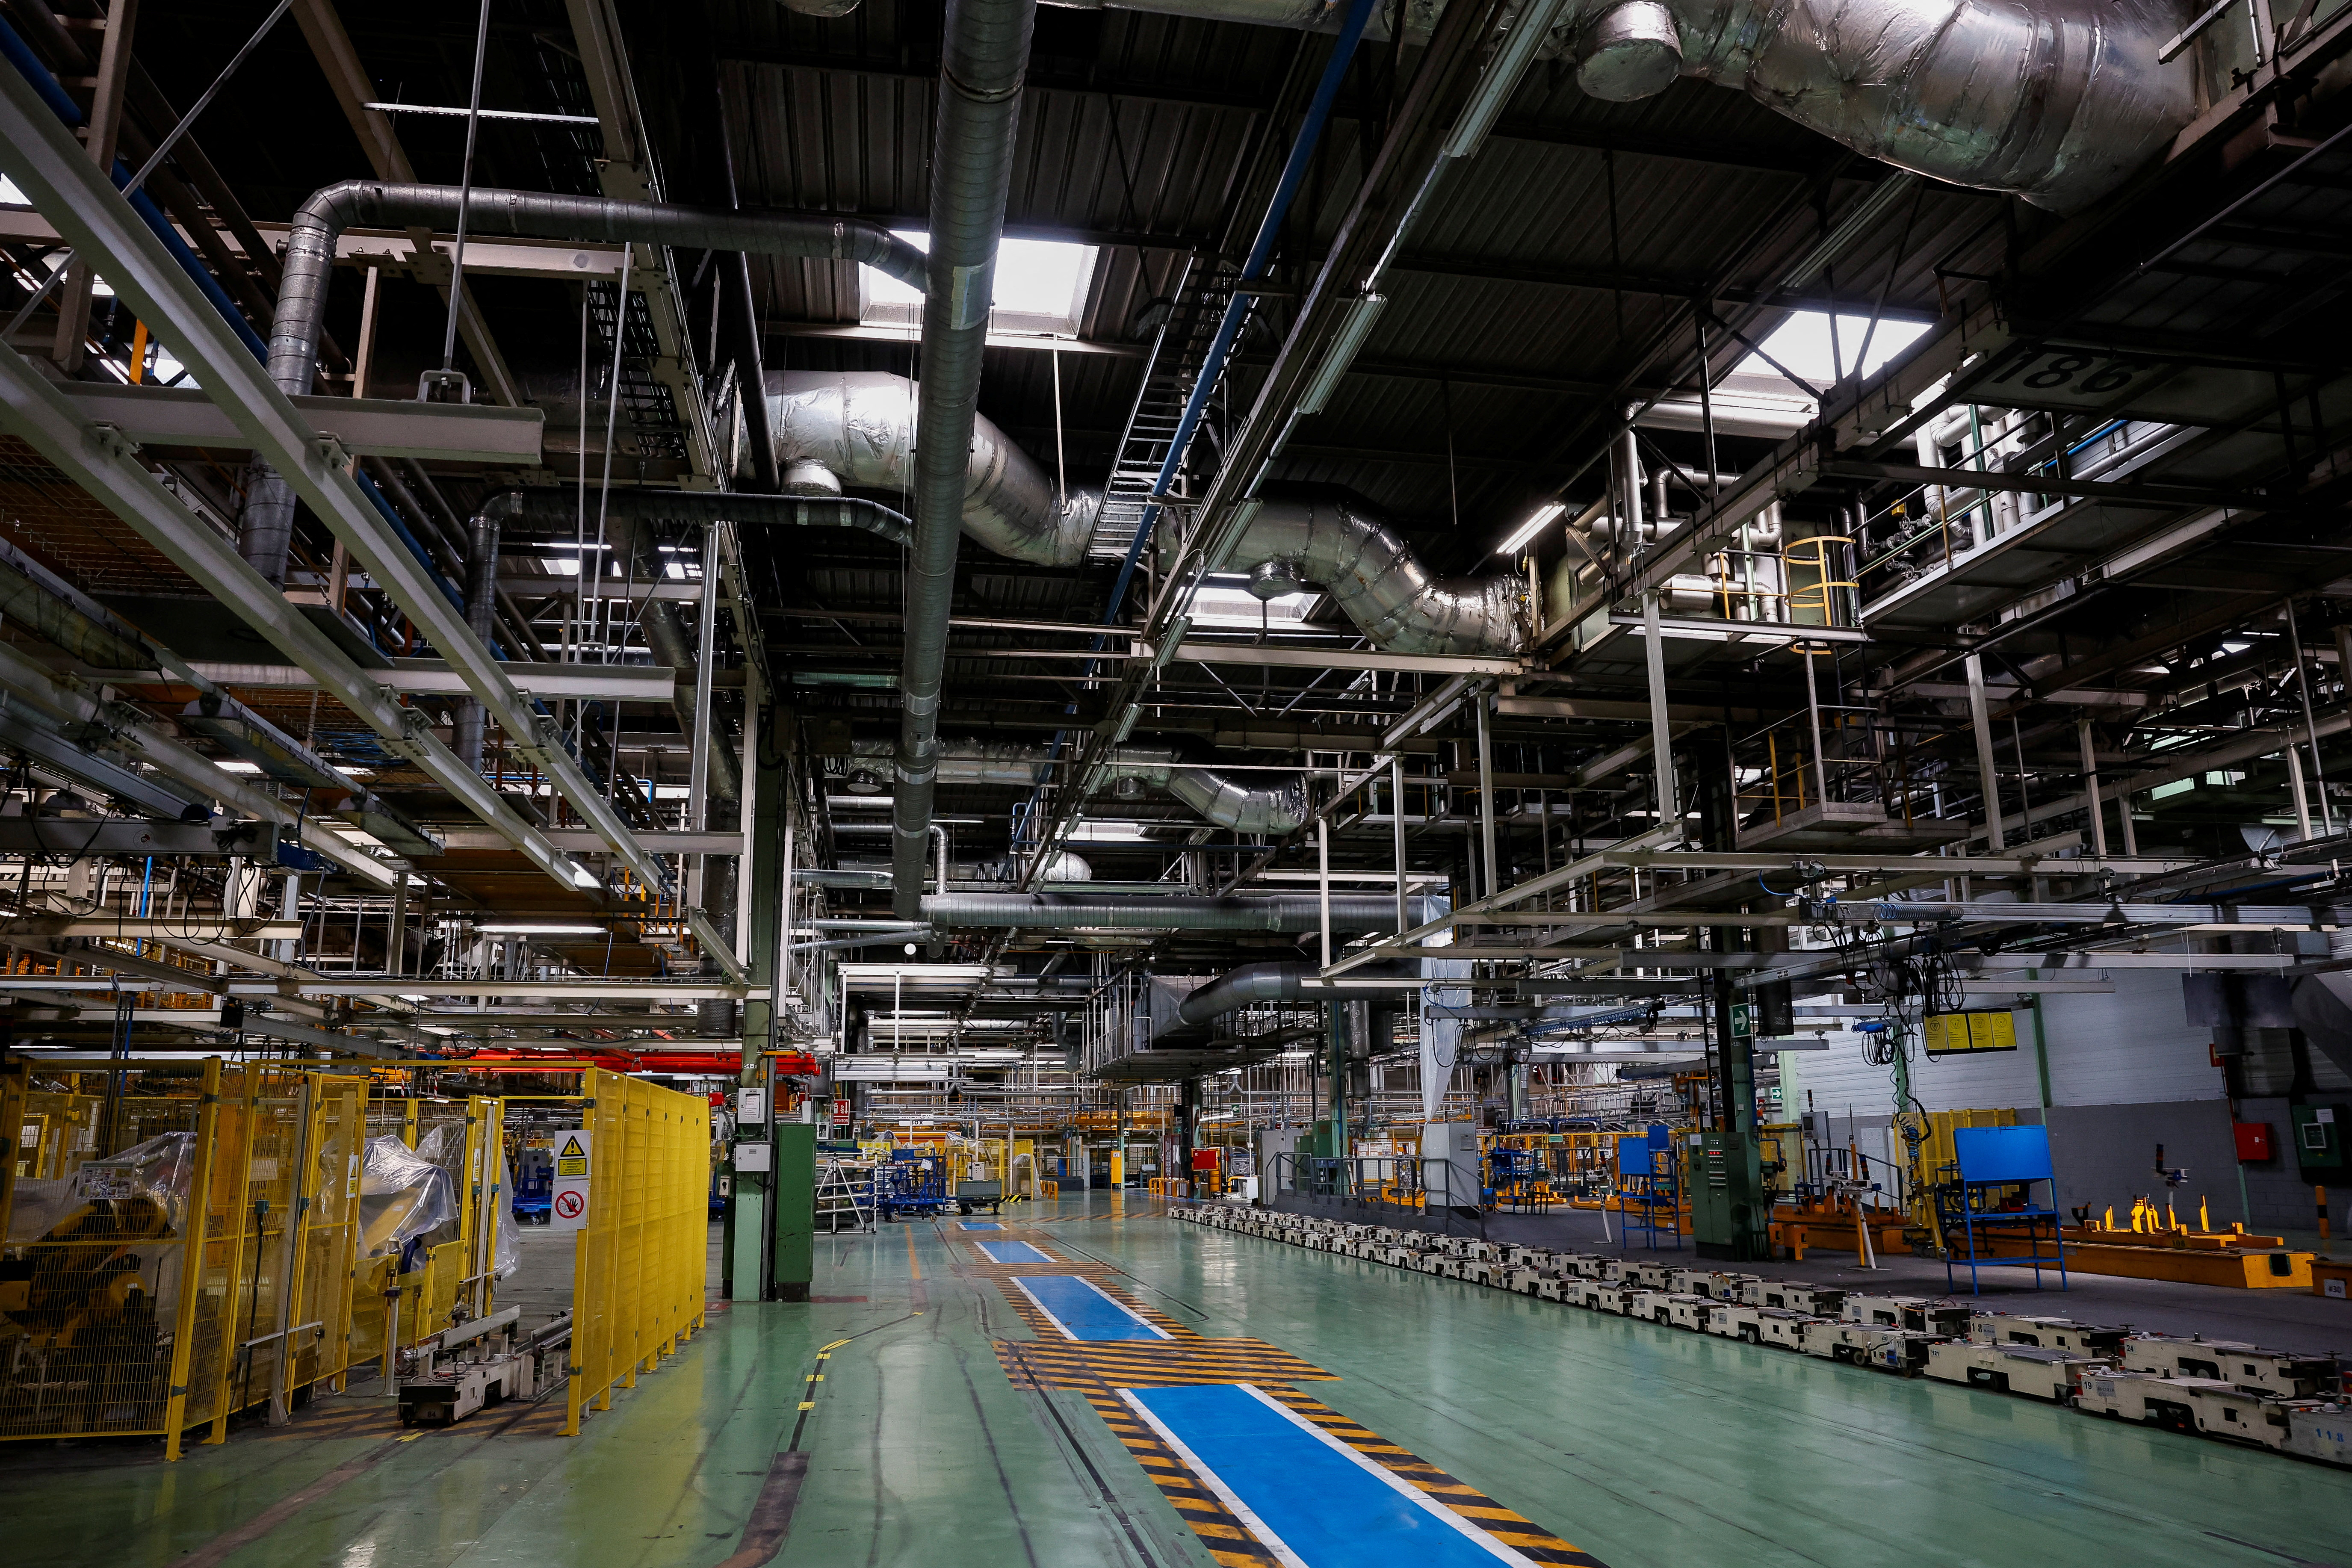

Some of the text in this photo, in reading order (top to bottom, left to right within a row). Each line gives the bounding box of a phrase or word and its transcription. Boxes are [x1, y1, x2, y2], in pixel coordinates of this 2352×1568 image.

[1991, 351, 2145, 393] 186
[1971, 1323, 1983, 1333] 18
[2084, 1381, 2092, 1390] 19
[2316, 1428, 2344, 1443] 118
